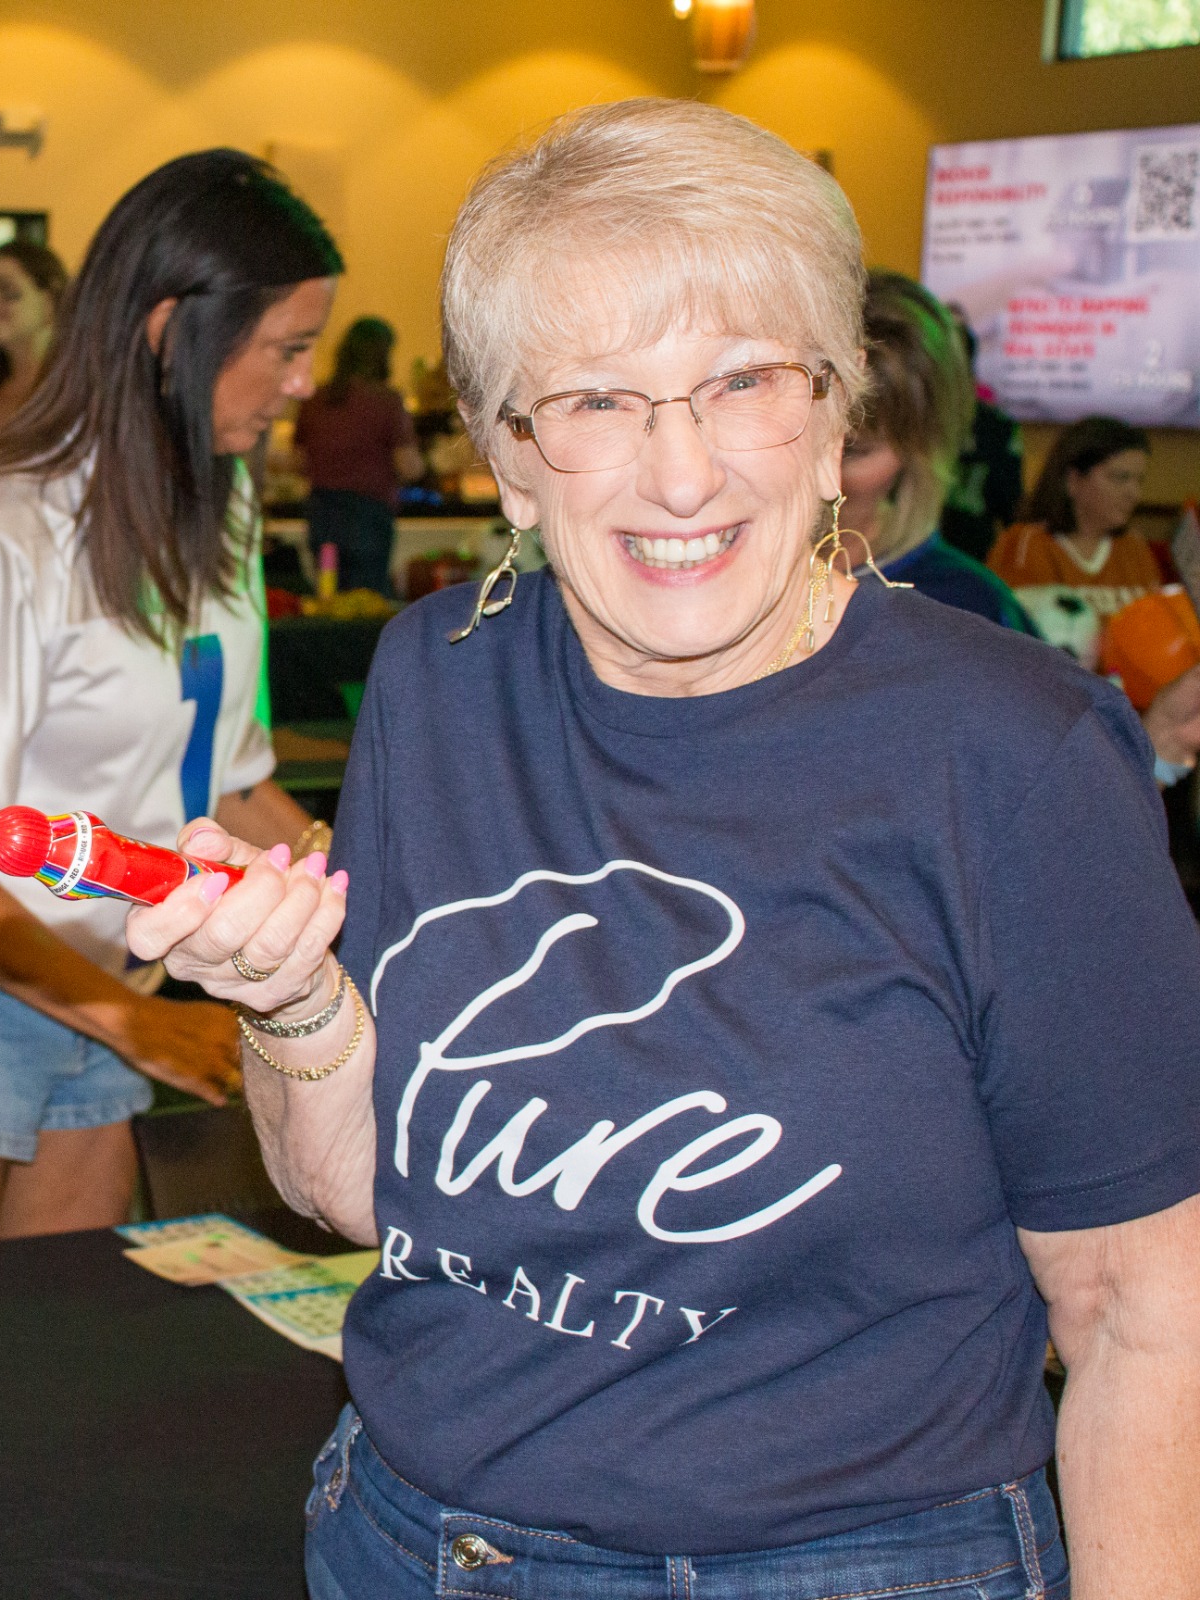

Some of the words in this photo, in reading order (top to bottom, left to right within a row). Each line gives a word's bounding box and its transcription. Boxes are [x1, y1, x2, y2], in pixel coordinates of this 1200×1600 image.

[69, 867, 80, 881] RED
[77, 840, 88, 862] ROUGE
[370, 859, 843, 1244] Pure
[378, 1225, 738, 1350] REALTY
